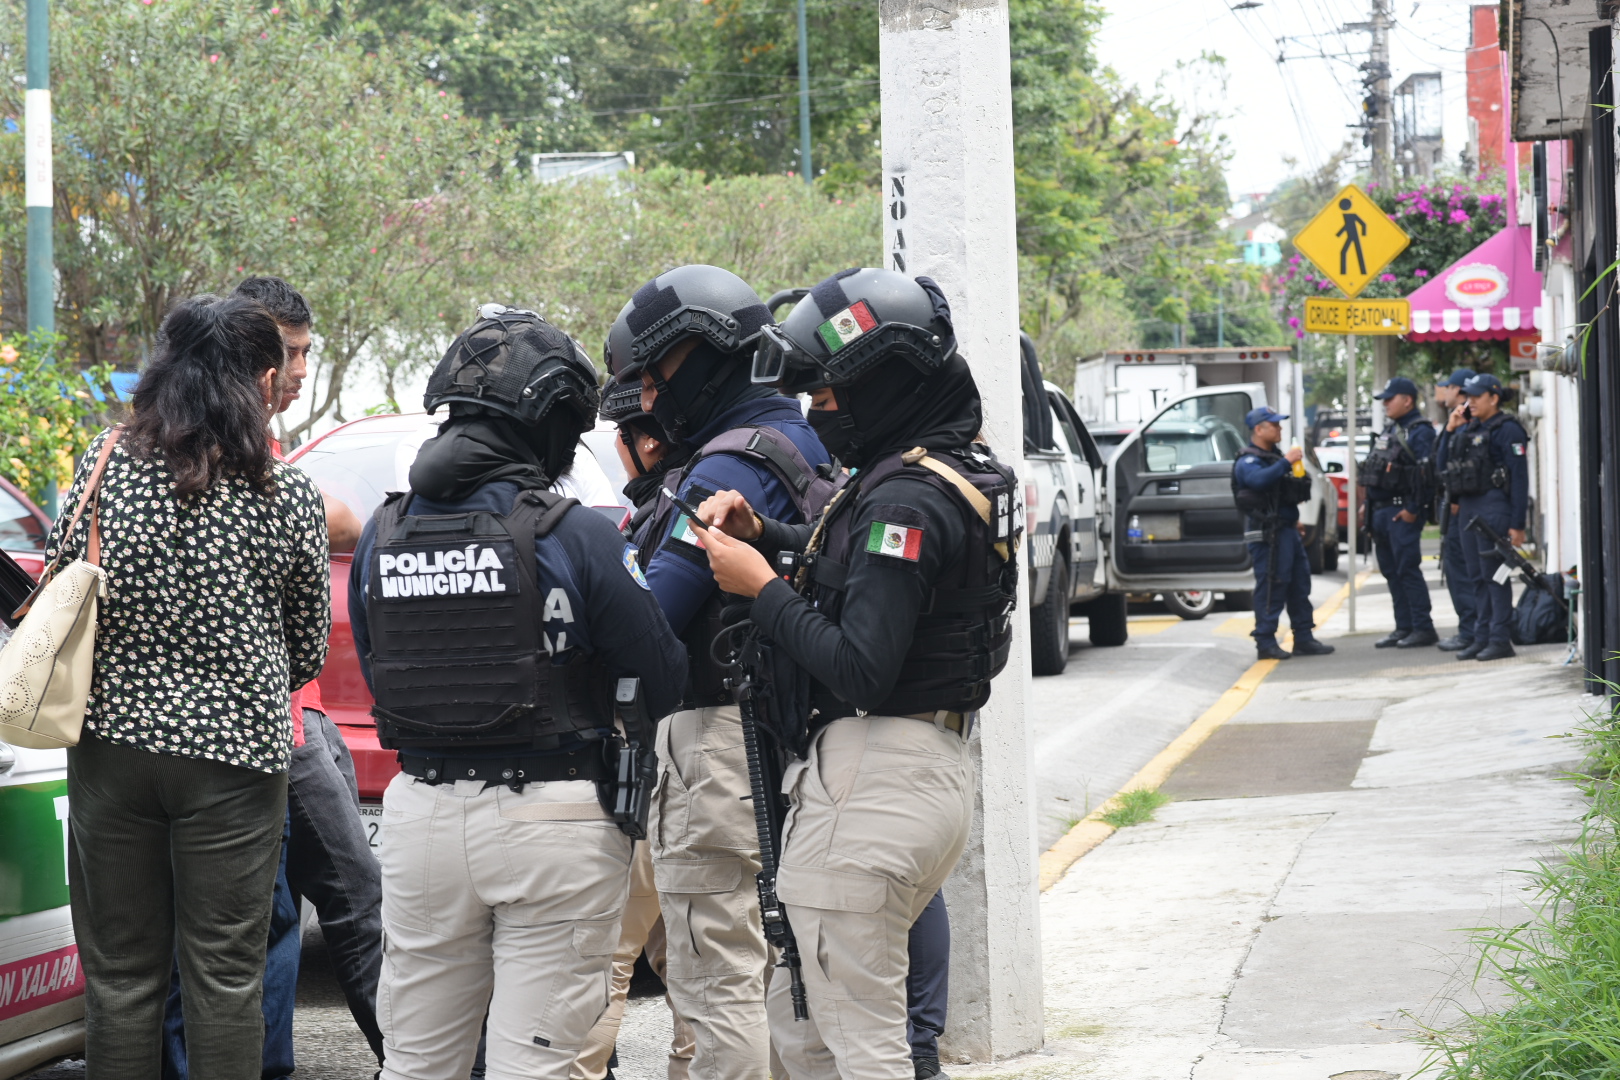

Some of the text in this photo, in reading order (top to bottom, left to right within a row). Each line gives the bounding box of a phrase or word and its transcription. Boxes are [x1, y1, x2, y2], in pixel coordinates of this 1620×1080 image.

[1310, 305, 1402, 326] CRUCE PEATONAL
[379, 544, 504, 576] POLICÍA
[381, 570, 506, 598] MUNICIPAL
[14, 952, 79, 1004] XALAPA
